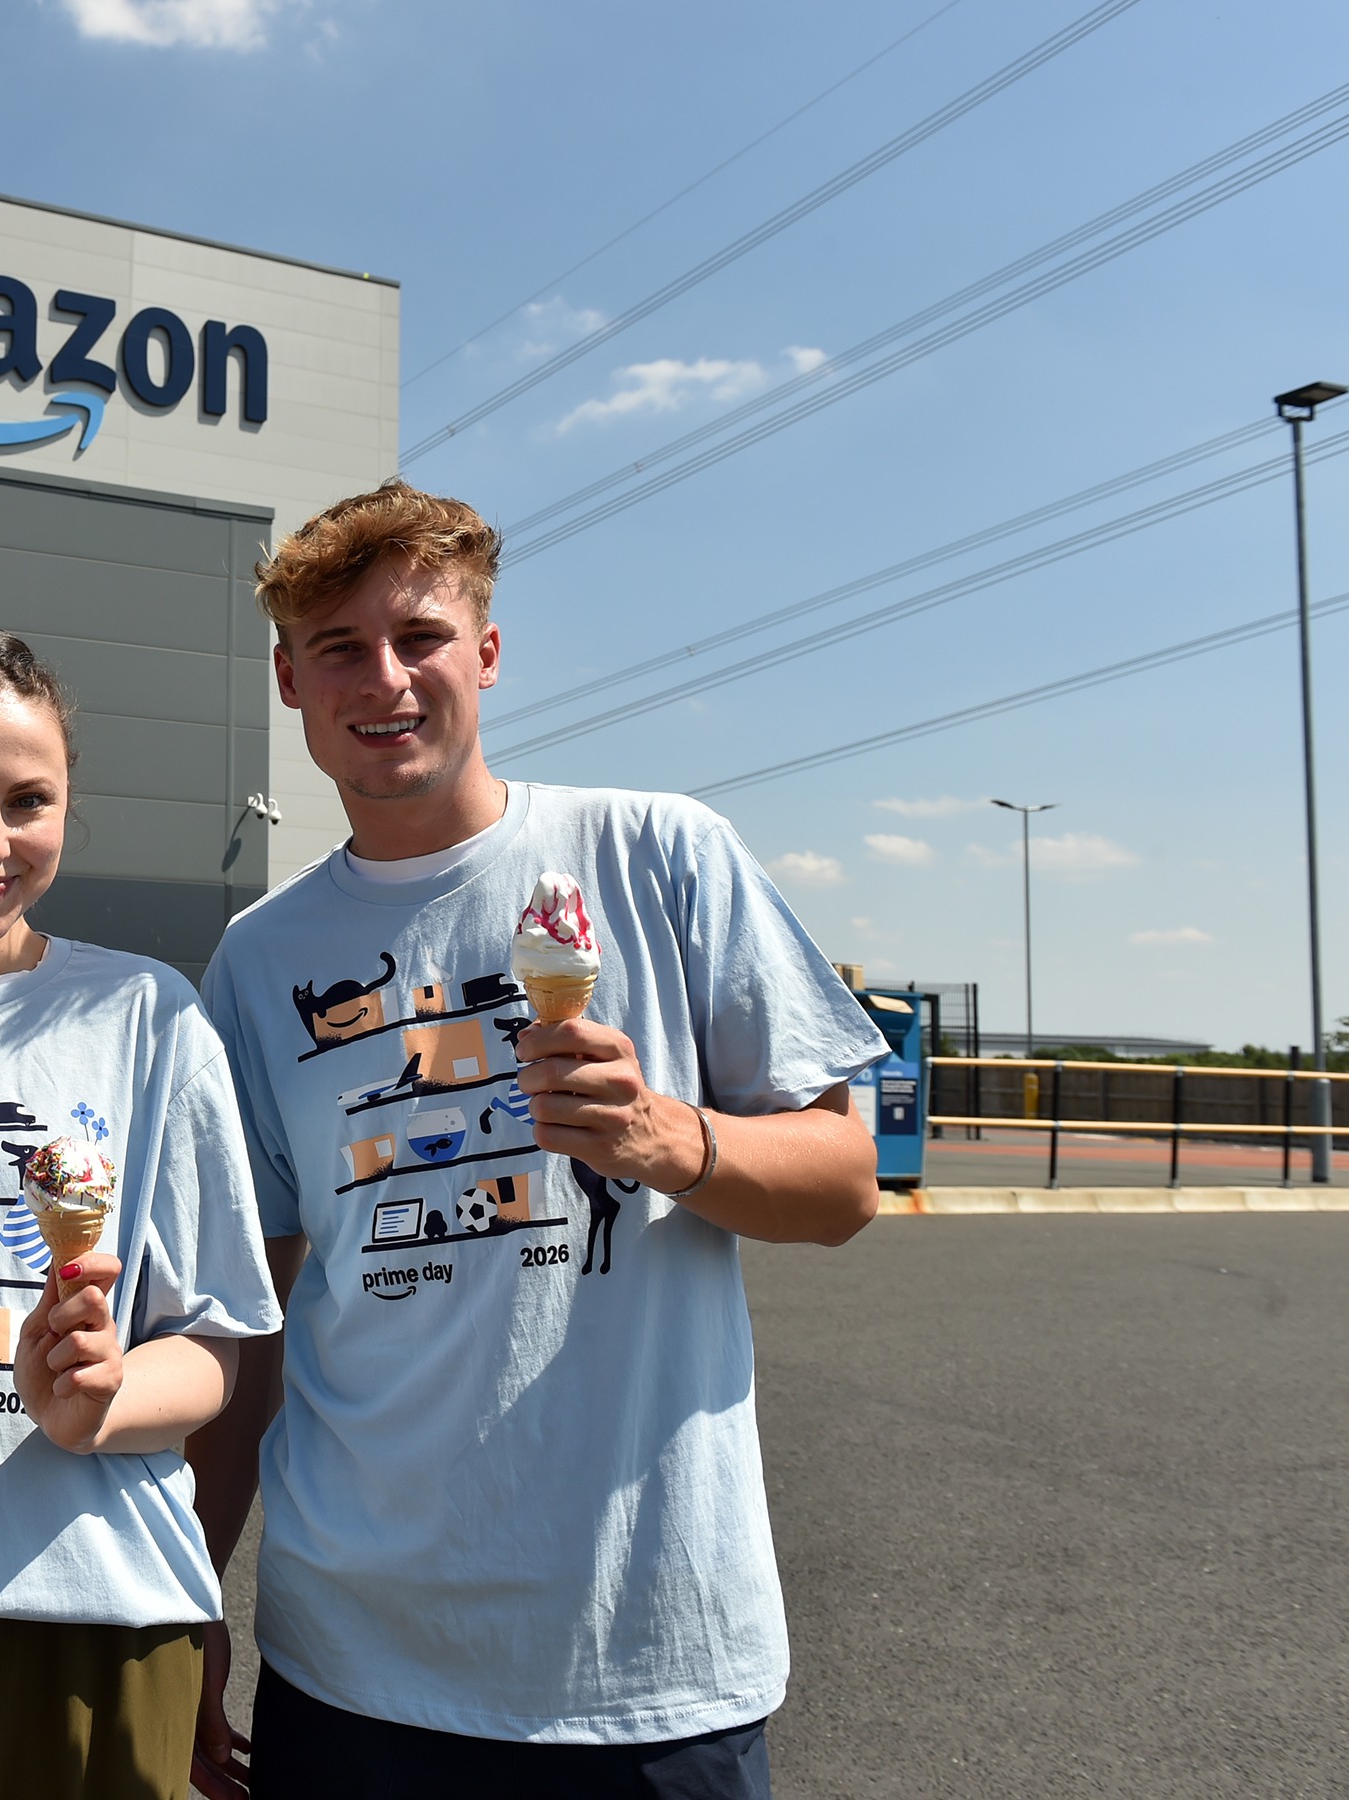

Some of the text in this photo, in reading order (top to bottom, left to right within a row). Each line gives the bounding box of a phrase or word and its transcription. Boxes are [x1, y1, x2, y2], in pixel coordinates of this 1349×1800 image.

[520, 1243, 570, 1268] 2026
[362, 1261, 453, 1292] prime day
